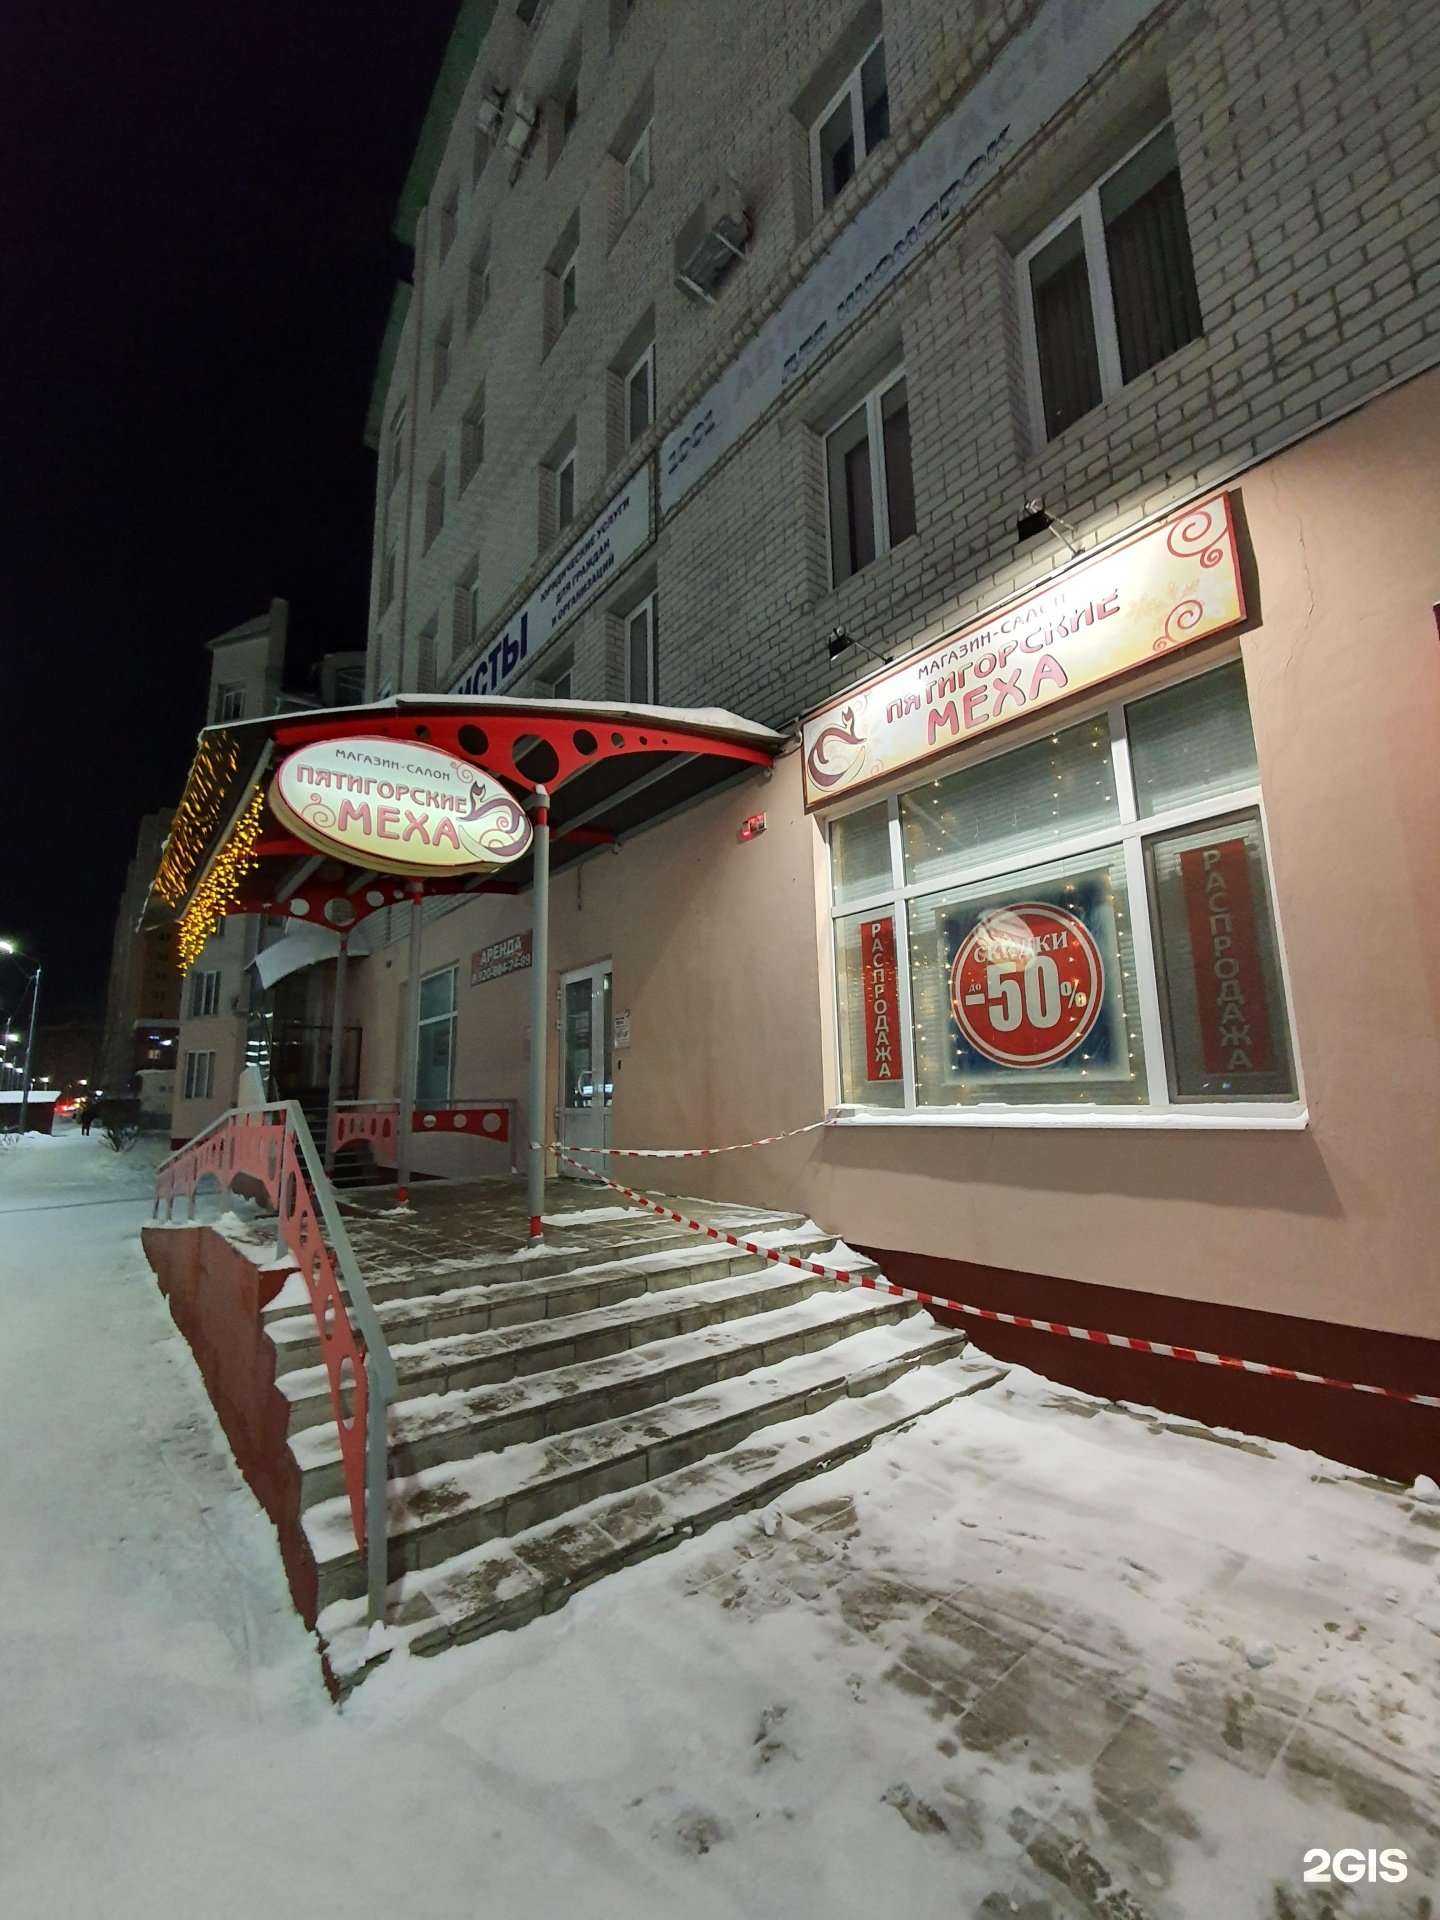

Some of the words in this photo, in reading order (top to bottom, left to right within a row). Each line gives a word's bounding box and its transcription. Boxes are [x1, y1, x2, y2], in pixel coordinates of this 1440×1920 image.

[596, 495, 630, 541] УСЛУГИ
[555, 580, 572, 607] ДЛЯ
[571, 537, 610, 587] ГРАЖДАН
[557, 552, 614, 621] ОРГАНИЗАЦИЙ
[885, 587, 1120, 724] ПЯТИГОРСКИЕ
[917, 592, 1066, 680] МАГАЗИН-САЛН
[927, 653, 1068, 746] МЕХА
[296, 763, 468, 815] ПЯТИГОРСКИЕ
[335, 748, 451, 782] МАГАЗИН-САЛОН
[337, 798, 461, 850] МЕХА
[1202, 849, 1253, 1072] РАСПРОДАЖА
[871, 922, 892, 1079] РАСПРОДАЖА
